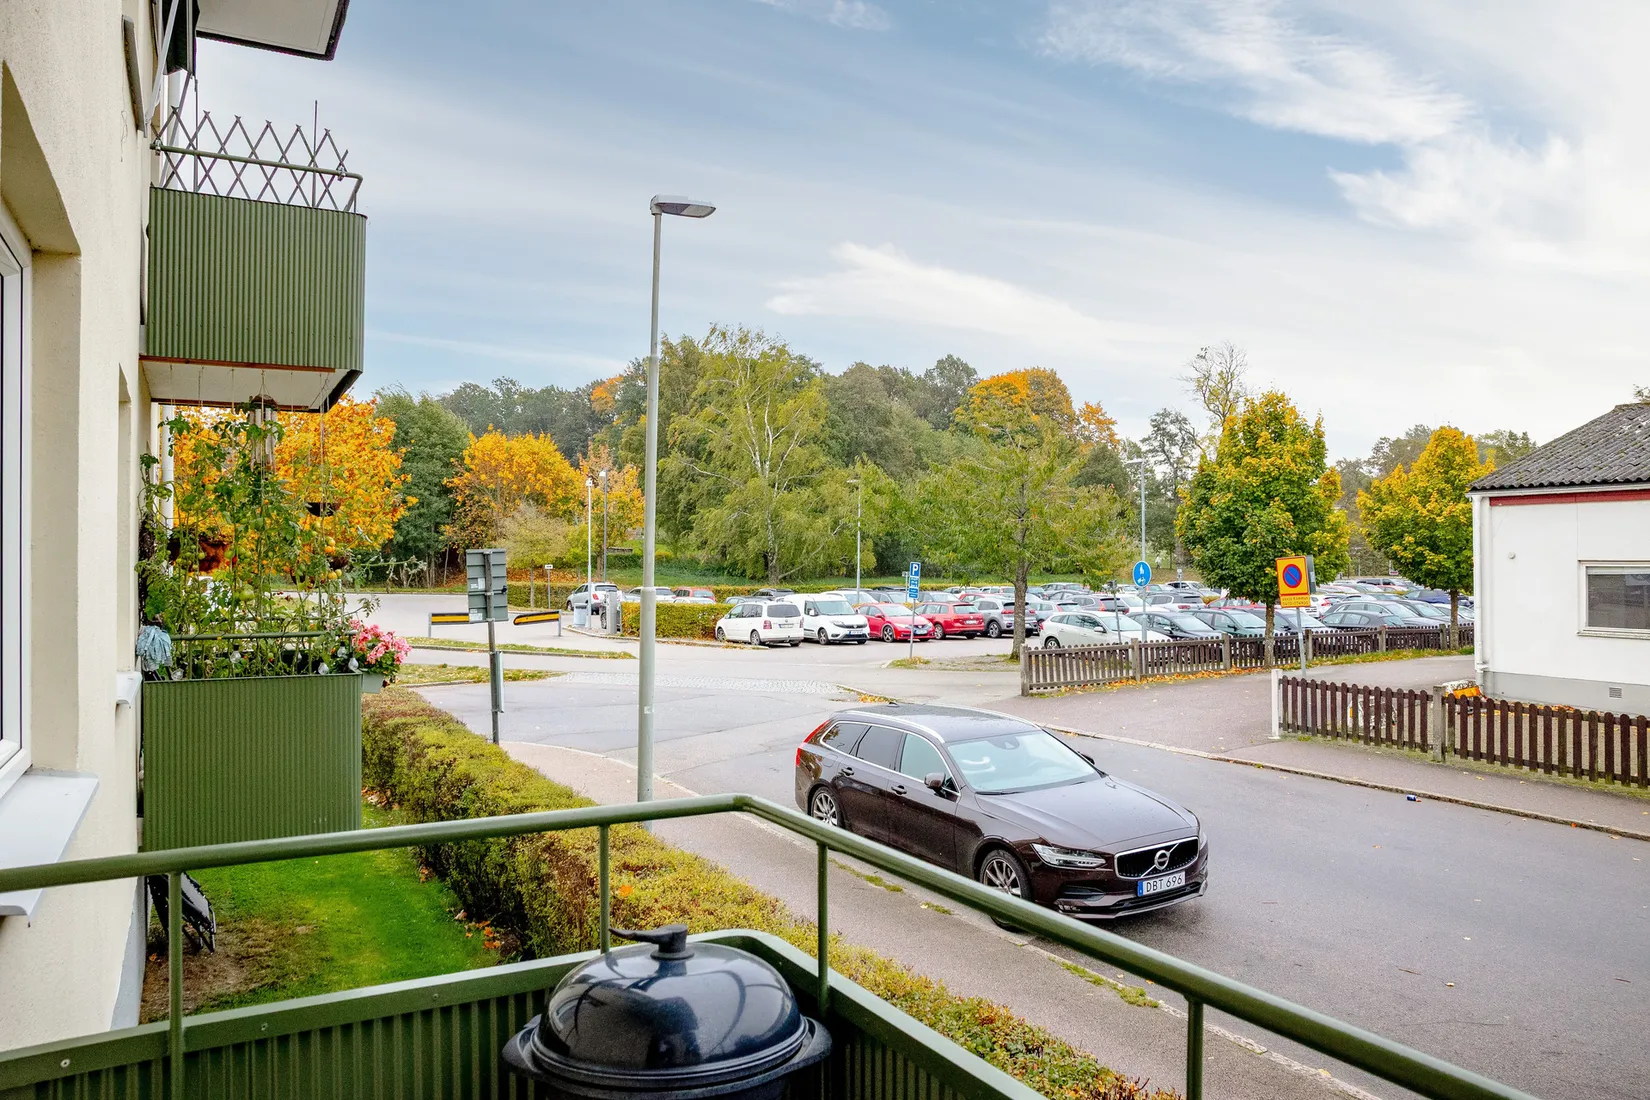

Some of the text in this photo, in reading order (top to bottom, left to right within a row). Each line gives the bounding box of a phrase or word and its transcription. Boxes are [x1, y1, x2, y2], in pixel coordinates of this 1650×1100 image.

[912, 564, 918, 575] P
[1146, 874, 1182, 892] DBT 696
